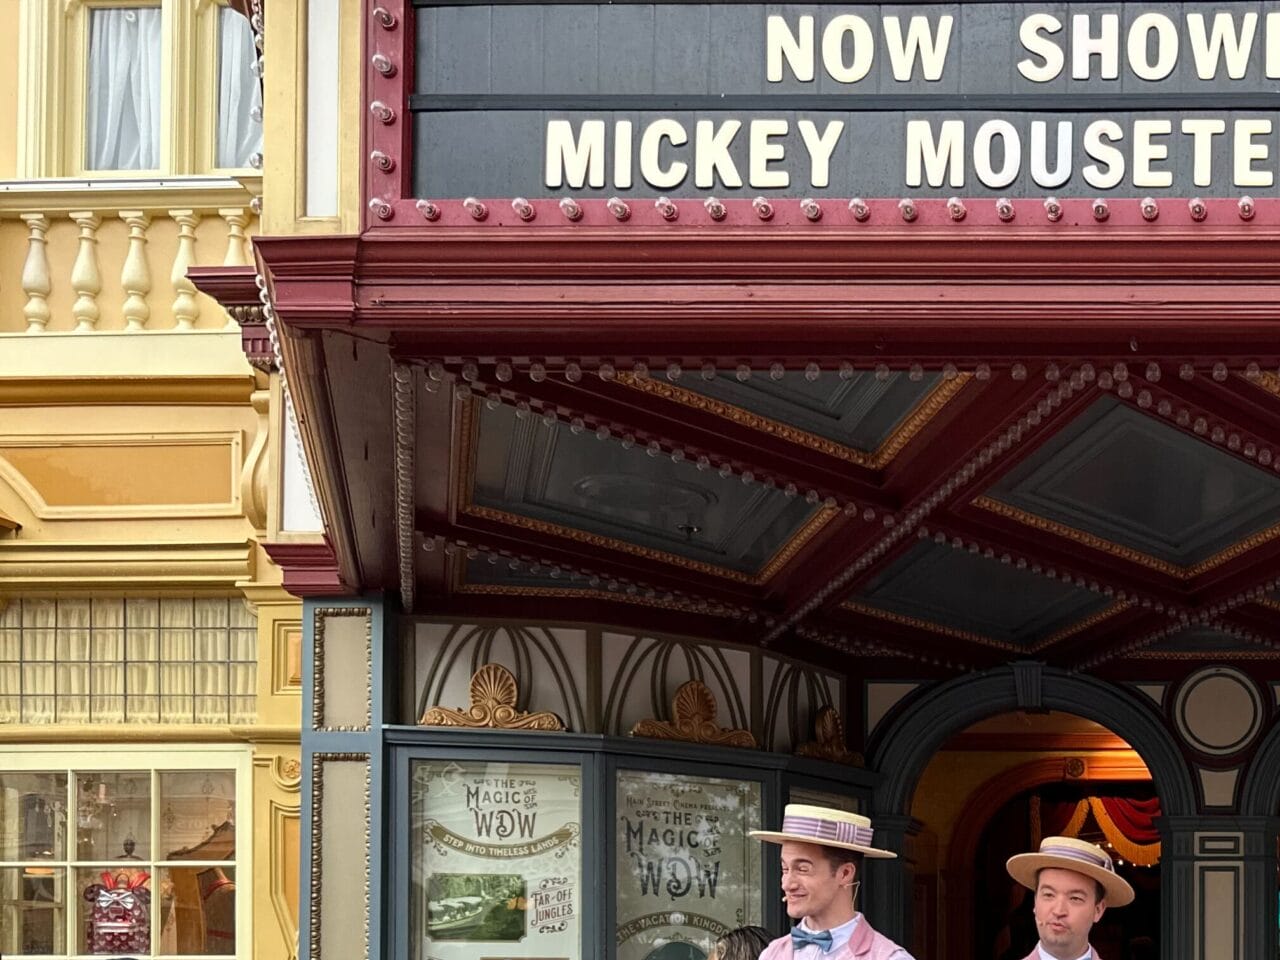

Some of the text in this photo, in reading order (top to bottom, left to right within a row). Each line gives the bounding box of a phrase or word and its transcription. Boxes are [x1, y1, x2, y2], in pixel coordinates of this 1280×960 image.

[765, 12, 955, 84] NOW
[544, 117, 846, 189] MICKEY
[494, 778, 516, 789] THE
[462, 784, 537, 810] MAGIC OF
[469, 808, 537, 840] WDW
[663, 811, 692, 826] THE
[443, 833, 560, 857] STEP INTO TIMELESS LANDS
[621, 816, 700, 856] MAGIC
[630, 852, 721, 901] WDW
[531, 888, 573, 909] FAR-OFF
[531, 903, 574, 926] JUNGLES
[638, 914, 688, 928] VACATION
[693, 916, 730, 937] KINGDO
